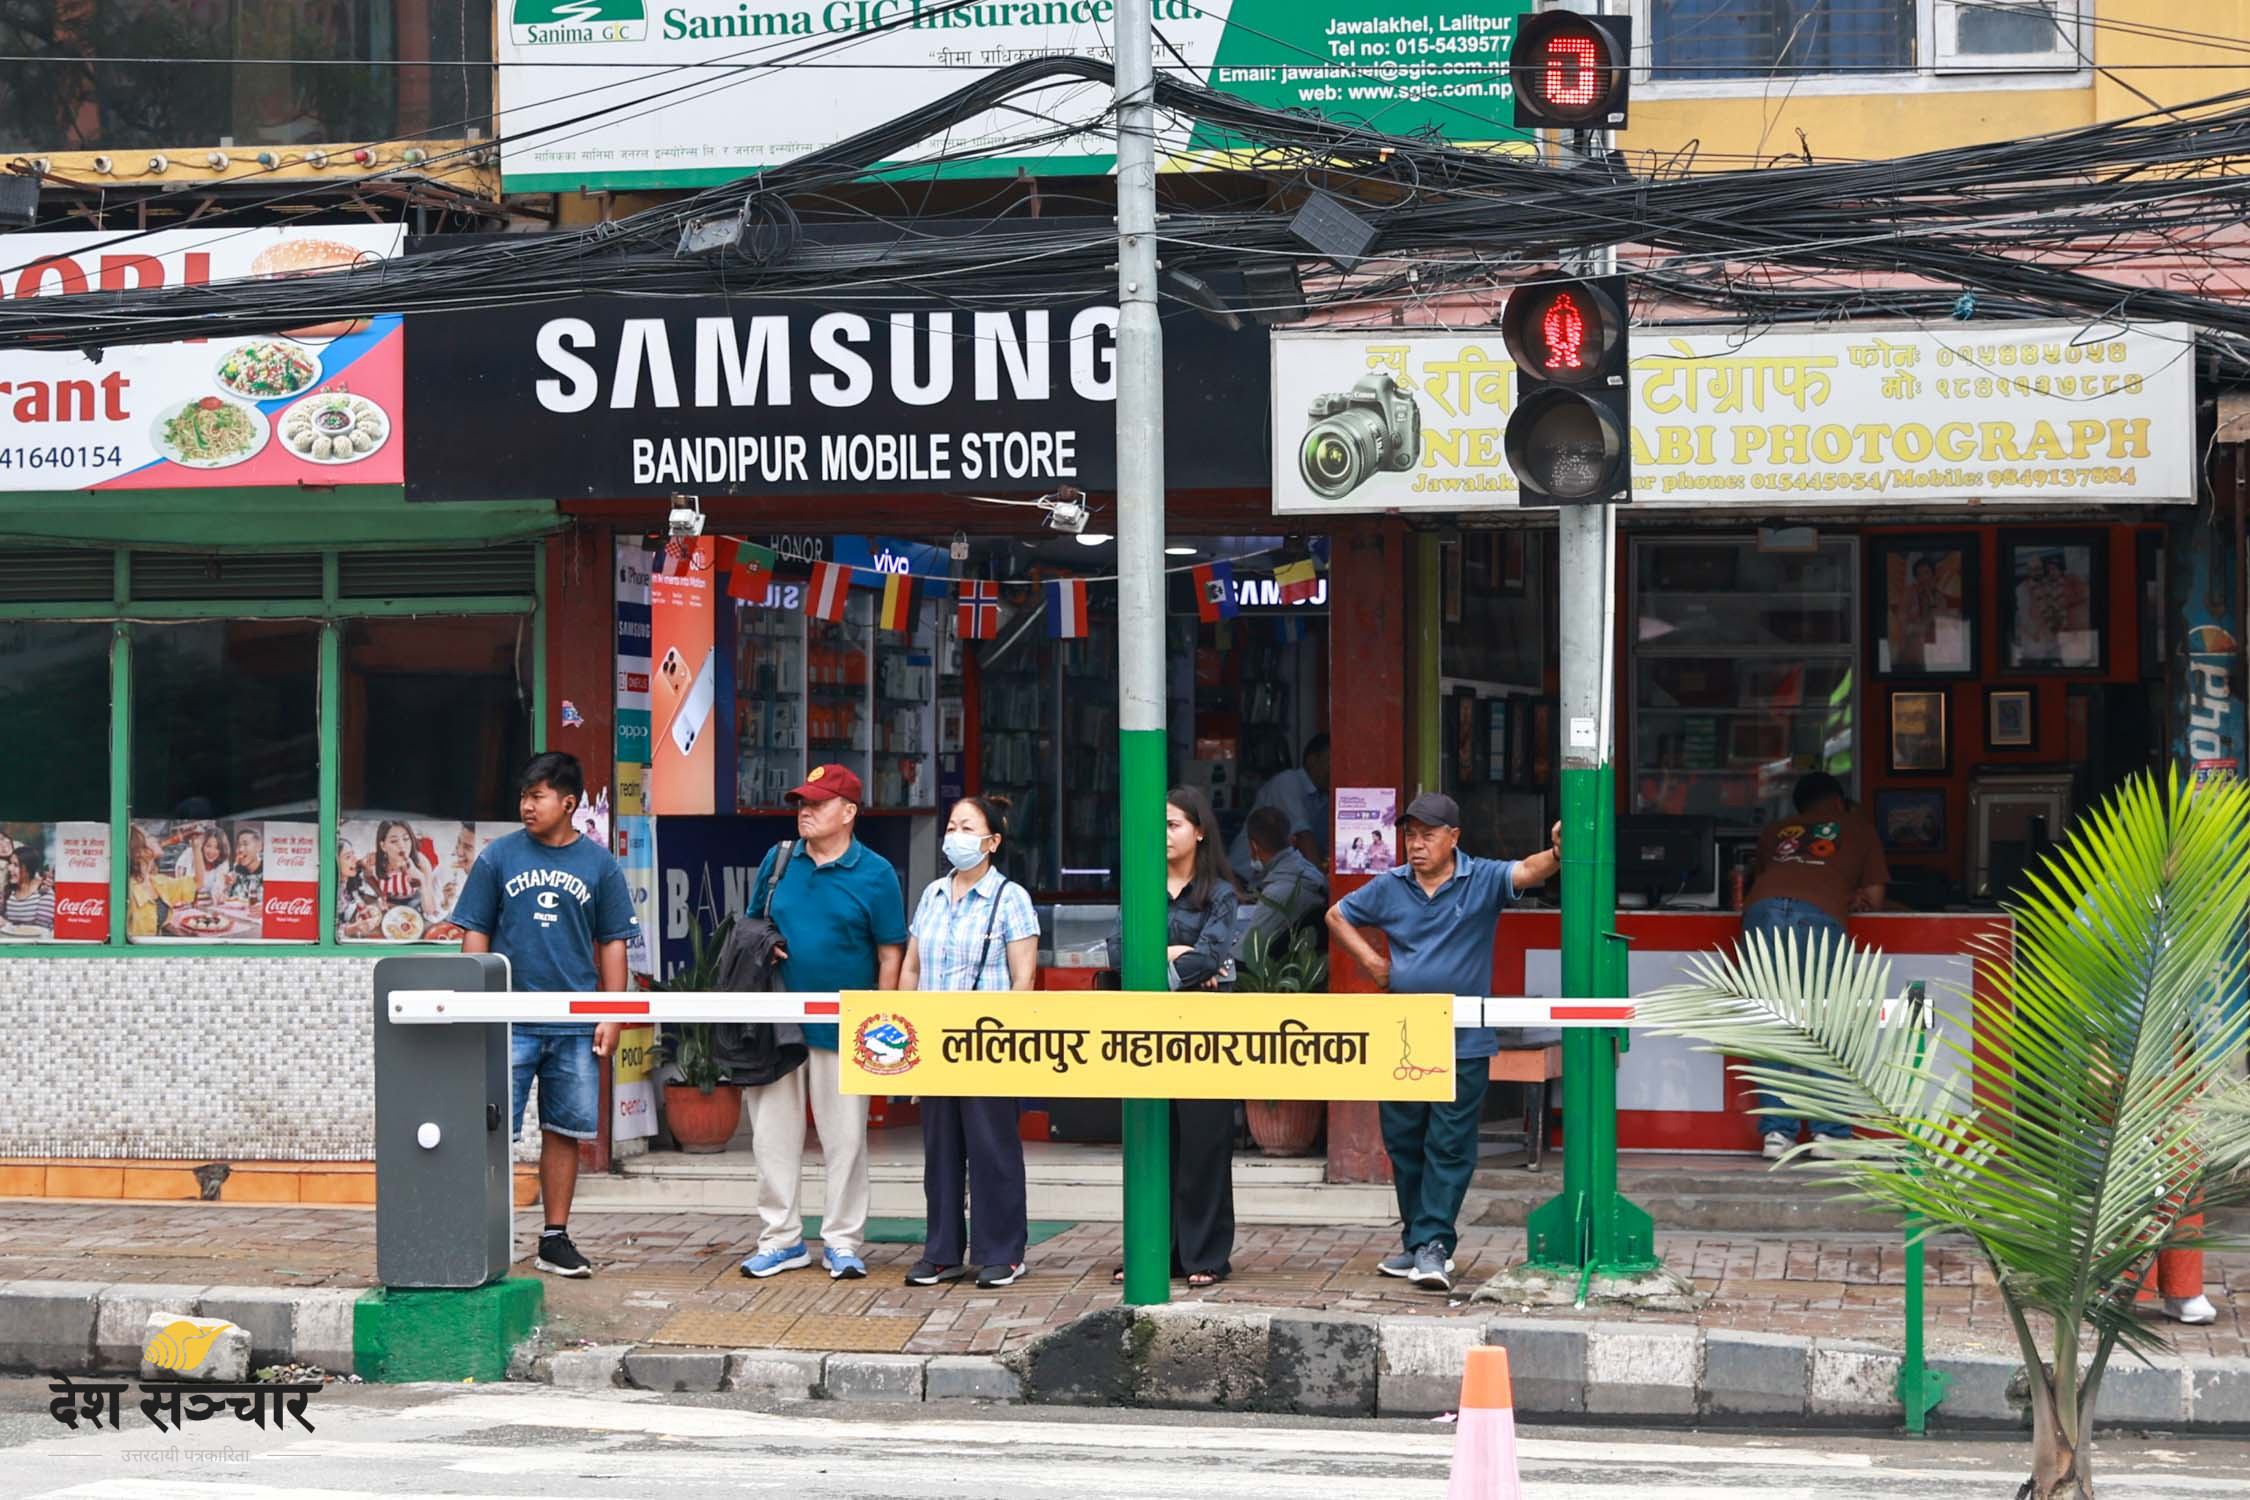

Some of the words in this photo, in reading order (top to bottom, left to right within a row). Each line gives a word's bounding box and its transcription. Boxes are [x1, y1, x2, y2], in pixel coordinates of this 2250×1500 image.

[663, 2, 814, 40] Sanima
[823, 0, 900, 33] GIC
[910, 0, 1114, 30] Insurance
[1152, 0, 1203, 20] td.
[1325, 17, 1433, 35] Jawalakhel,
[1439, 15, 1512, 33] Lalitpur
[528, 25, 593, 43] Sanima
[1328, 40, 1355, 56] Tel
[1361, 41, 1390, 56] no:
[1396, 36, 1511, 55] 015-5439577
[1219, 65, 1276, 82] Email:
[1299, 85, 1342, 101] web:
[1348, 82, 1513, 101] www.sgic.com.np
[535, 306, 1118, 413] SAMSUNG
[1366, 345, 1419, 391] न्यू
[1423, 345, 1517, 417] रवि
[1629, 338, 1838, 414] टोग्राफ
[1421, 428, 1506, 468] NE
[1631, 425, 1717, 465] ABI
[1729, 418, 2151, 465] PHOTOGRAPH
[0, 446, 122, 469] 41640154
[633, 434, 807, 485] BANDIPUR
[821, 432, 951, 482] MOBILE
[961, 430, 1077, 479] STORE
[1662, 472, 1745, 493] phone:
[1987, 466, 2136, 488] 9849137884
[770, 535, 824, 564] HONOR
[873, 548, 910, 574] vivo
[618, 724, 648, 741] oppo
[505, 869, 591, 906] CHAMPION
[621, 1047, 644, 1068] POCO
[941, 1017, 1090, 1073] ललितपुर
[1101, 1019, 1370, 1067] महानगरपालिका
